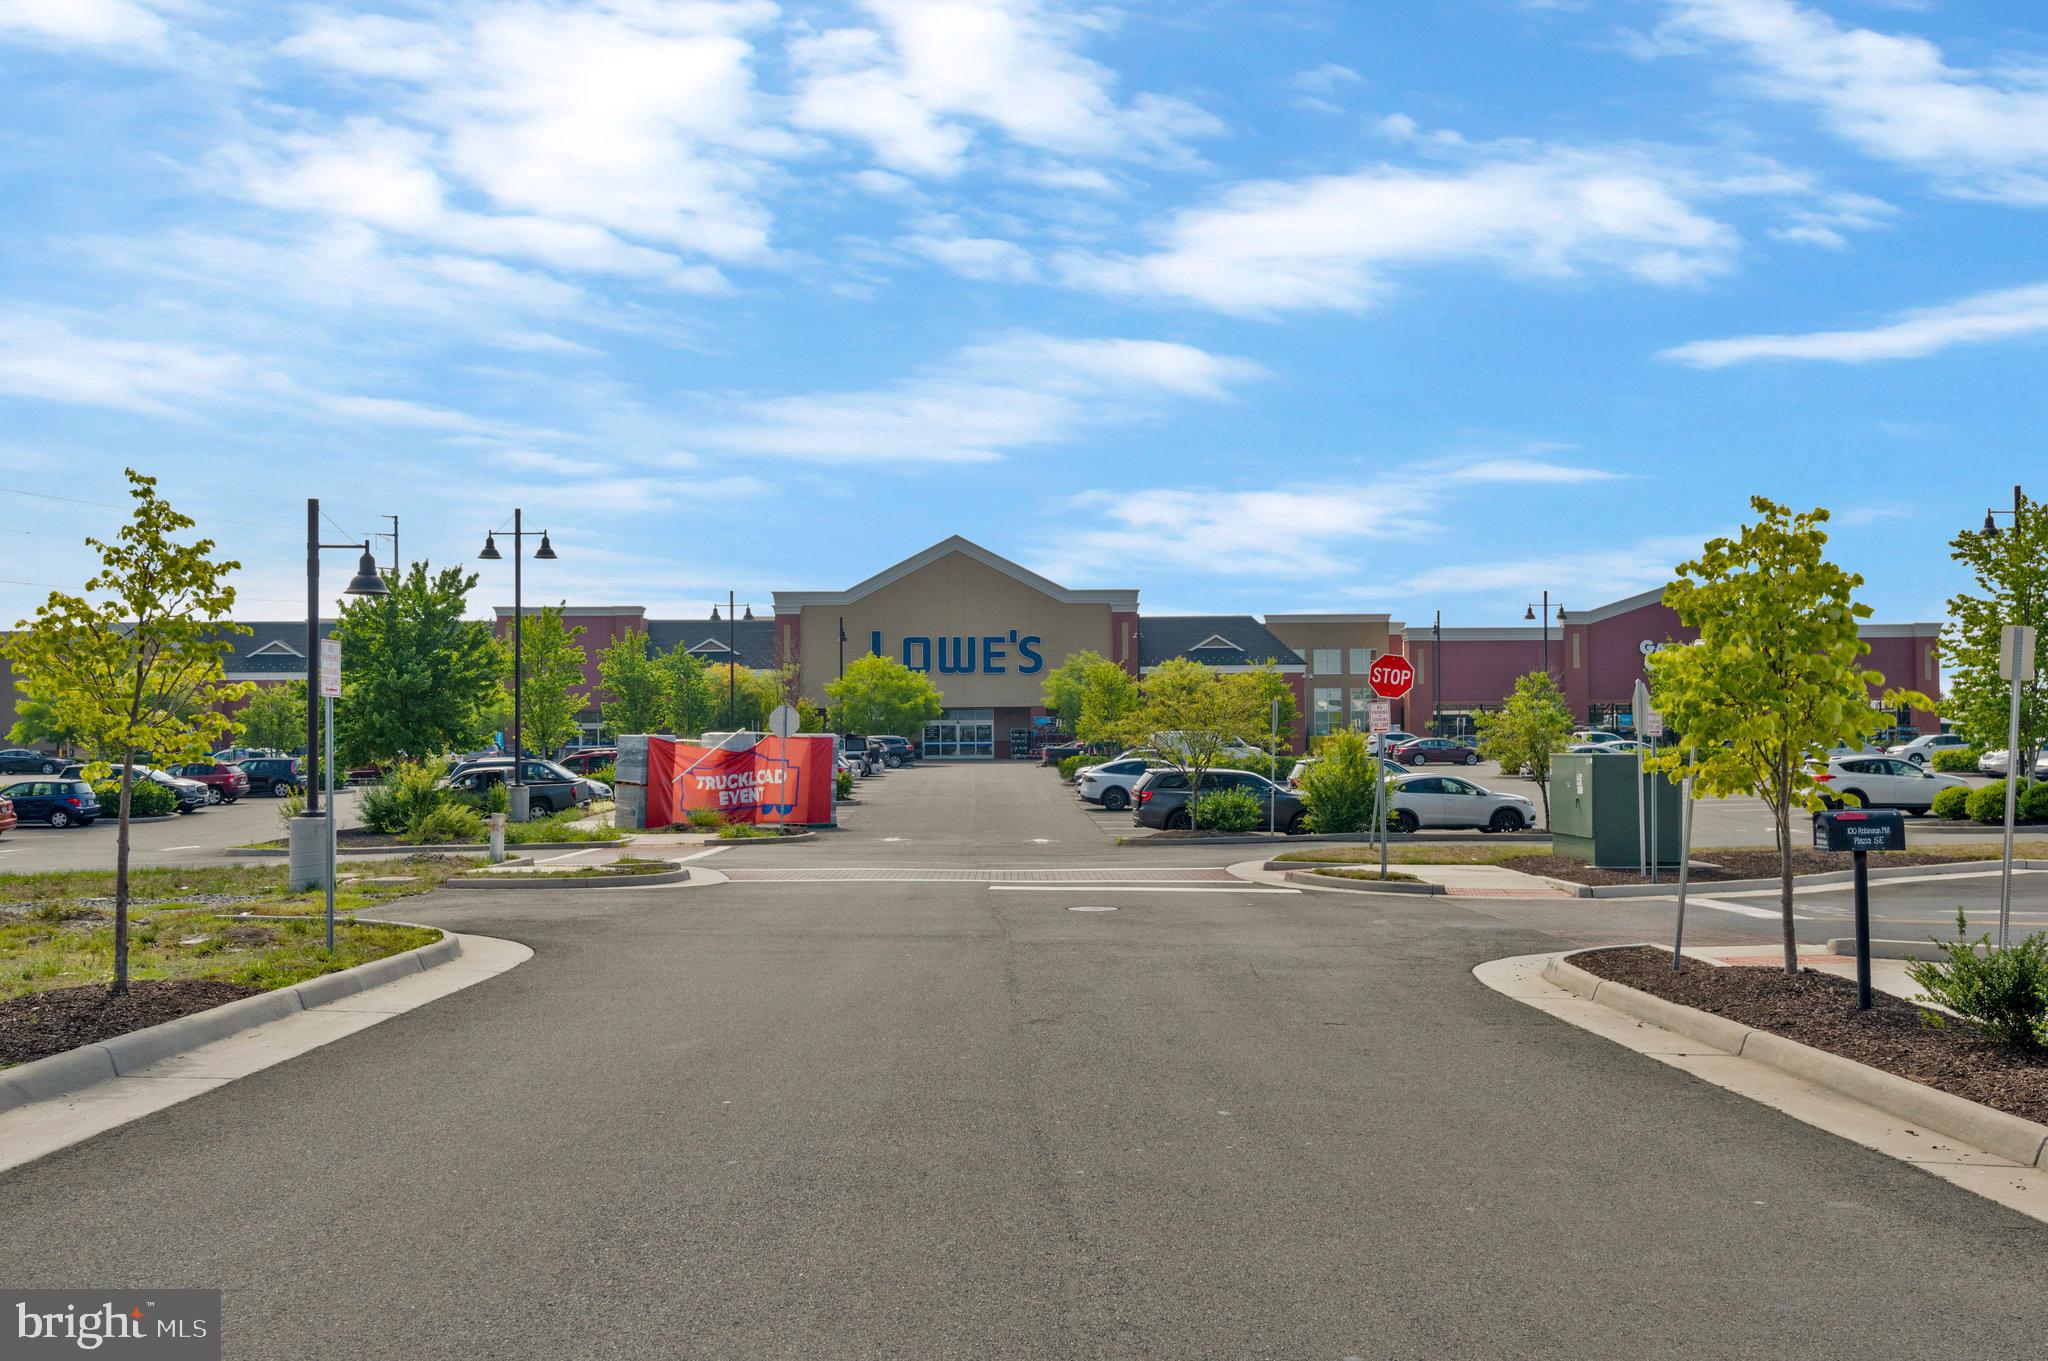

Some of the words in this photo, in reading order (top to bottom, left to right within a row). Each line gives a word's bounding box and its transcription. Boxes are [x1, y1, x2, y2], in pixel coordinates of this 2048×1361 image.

[1372, 667, 1410, 685] STOP
[695, 769, 787, 790] TRUCKLOAD
[719, 787, 764, 805] EVENT
[1853, 837, 1871, 845] Plaza
